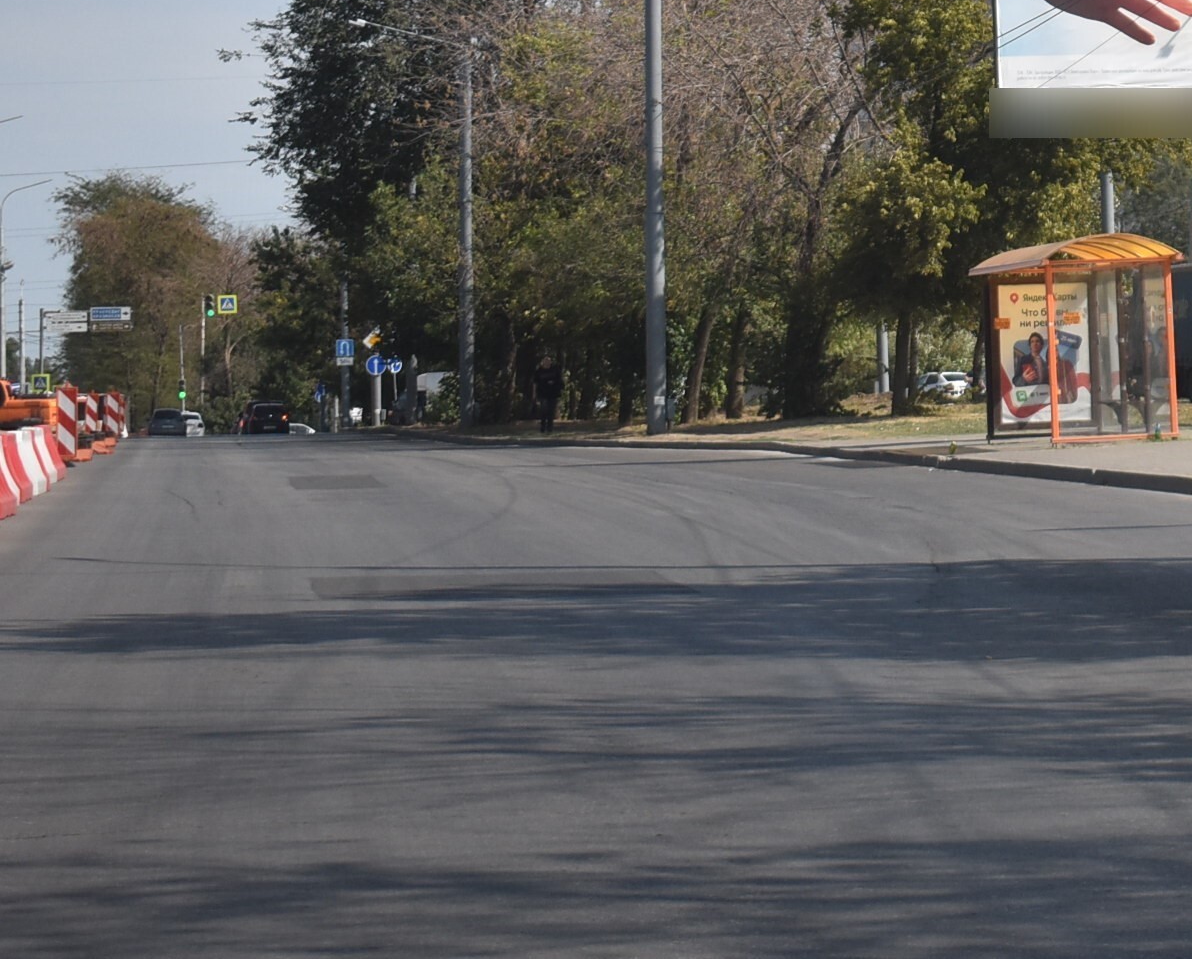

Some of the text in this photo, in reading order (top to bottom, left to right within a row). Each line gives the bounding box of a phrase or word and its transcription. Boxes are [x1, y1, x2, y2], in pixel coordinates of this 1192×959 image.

[1022, 293, 1047, 302] Яндек
[1021, 308, 1039, 317] Что
[1019, 320, 1032, 328] ни
